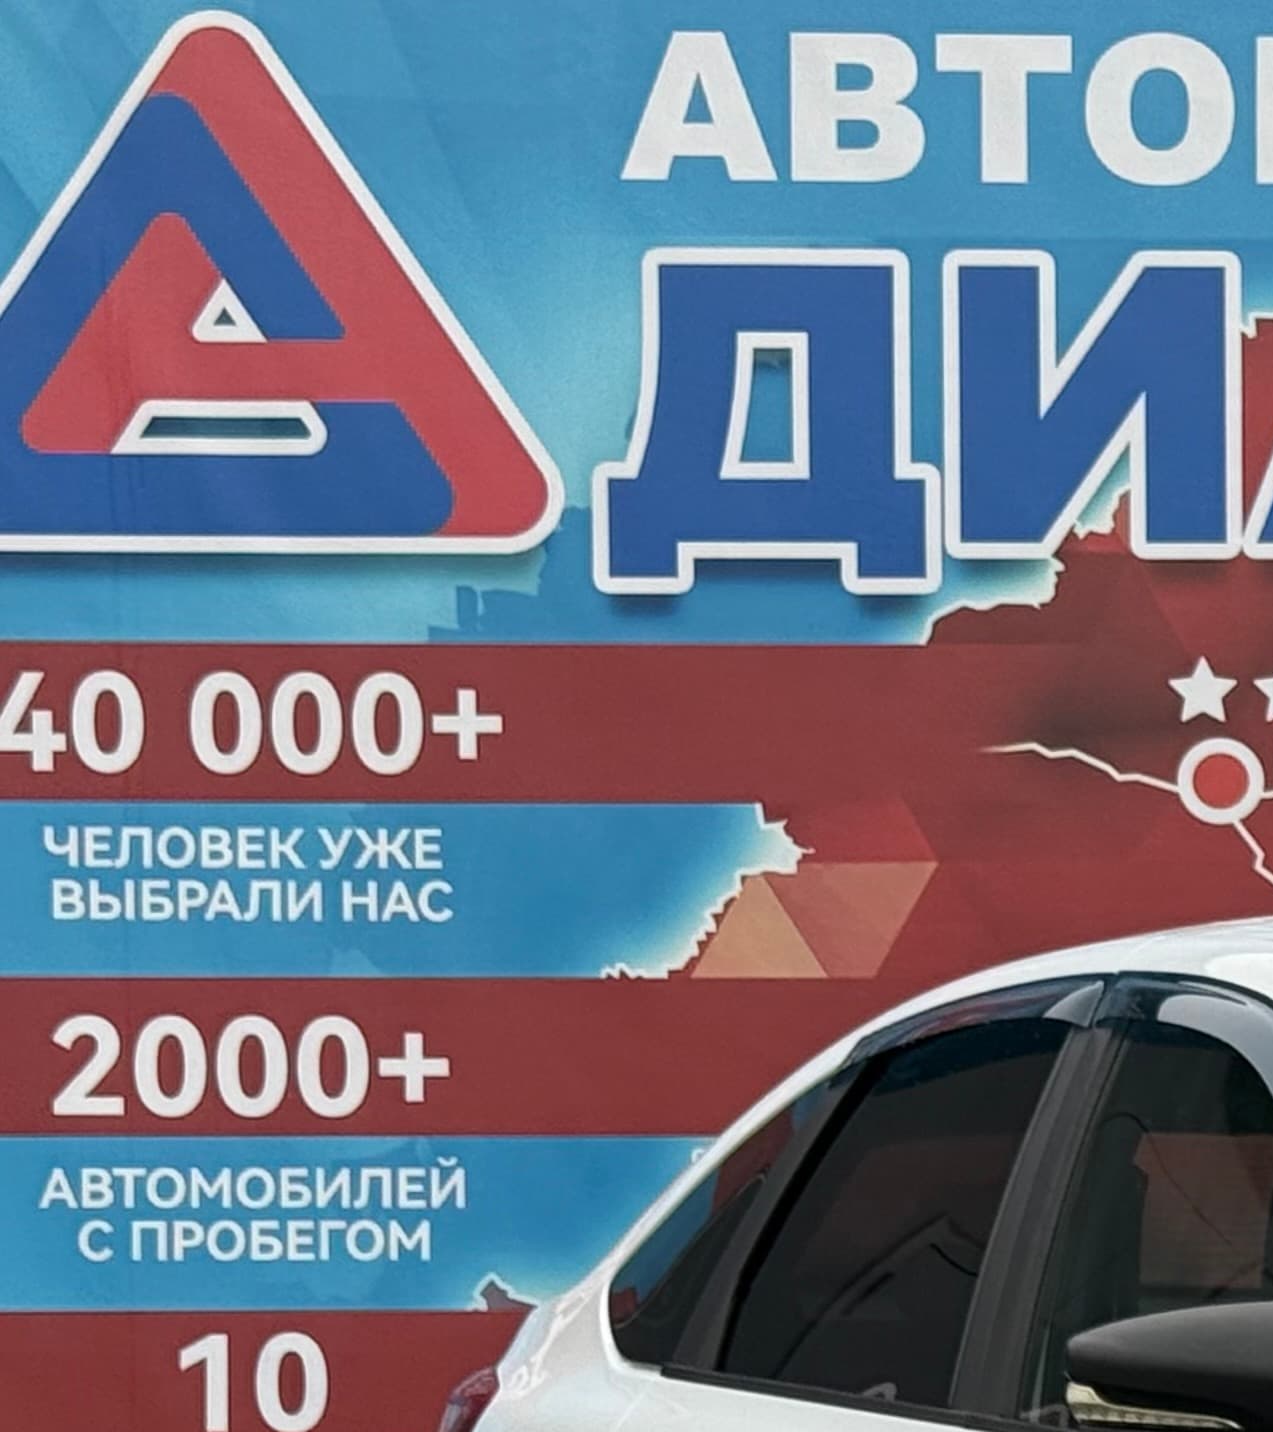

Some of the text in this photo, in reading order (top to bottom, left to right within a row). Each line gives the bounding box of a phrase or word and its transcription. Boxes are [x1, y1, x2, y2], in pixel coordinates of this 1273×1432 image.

[0, 671, 503, 775] 40 000+
[43, 826, 443, 870] ЧЕЛОВЕК УЖЕ
[52, 880, 453, 922] ВЫБРАЛИ НАС
[51, 1014, 450, 1118] 2000+
[39, 1157, 467, 1210] АВТОМОБИЛЕЙ
[77, 1219, 431, 1262] С ПРОБЕГОМ
